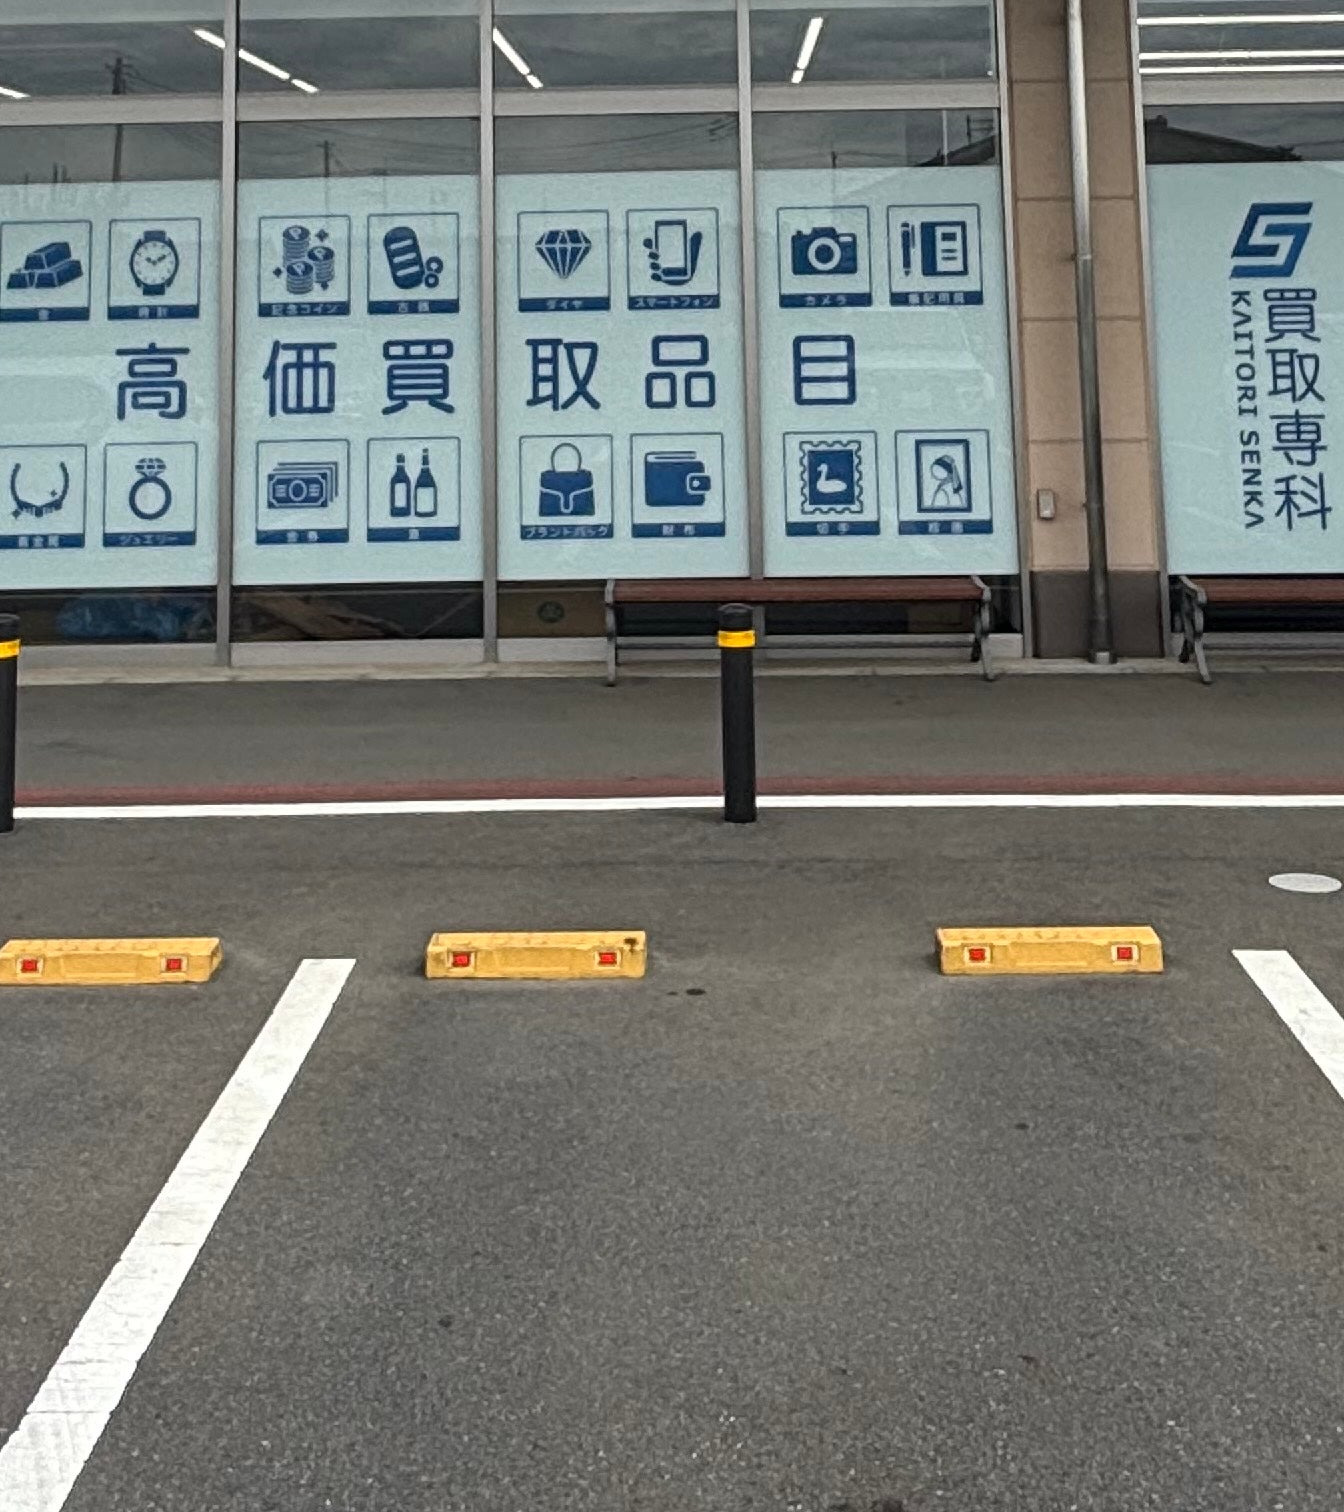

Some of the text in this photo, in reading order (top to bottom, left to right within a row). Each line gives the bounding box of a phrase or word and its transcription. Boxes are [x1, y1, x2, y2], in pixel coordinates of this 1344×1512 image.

[635, 296, 714, 308] スマートフォン
[806, 294, 847, 306] カメラ
[1230, 290, 1265, 530] KAITORI SENKA
[1263, 288, 1333, 532] 買取専科
